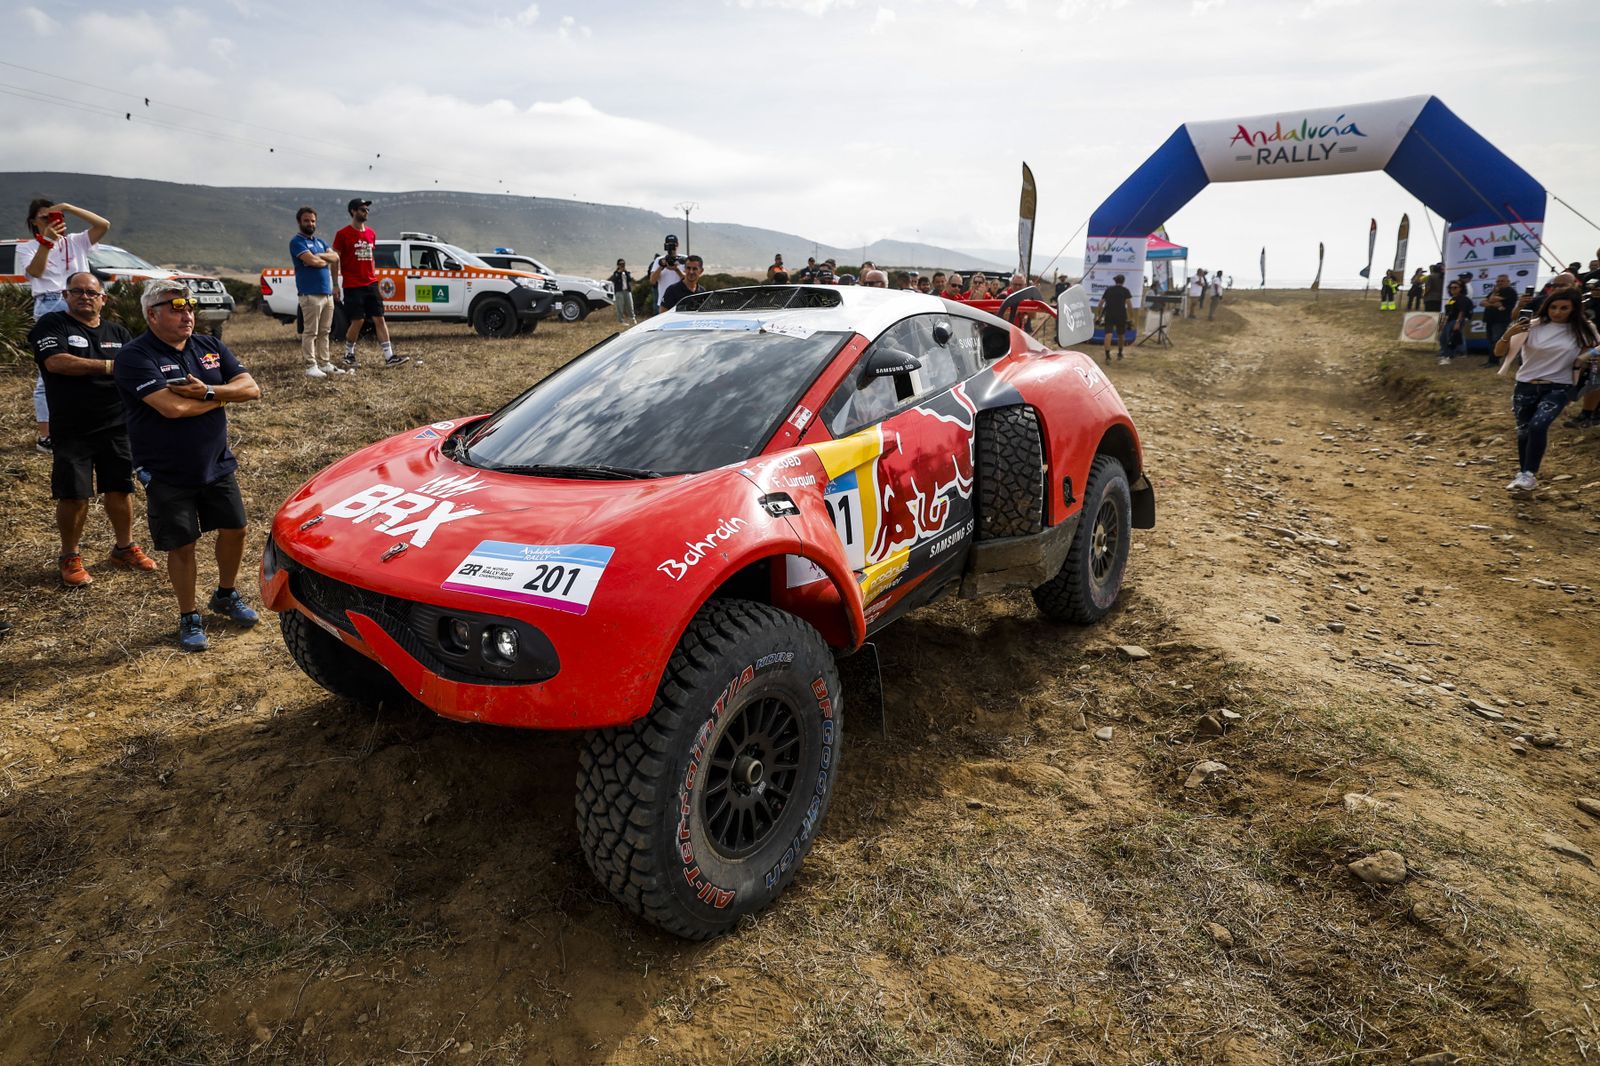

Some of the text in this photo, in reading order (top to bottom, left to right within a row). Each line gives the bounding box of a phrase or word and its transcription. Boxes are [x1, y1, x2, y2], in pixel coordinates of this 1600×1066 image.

[1230, 113, 1368, 148] Andalucía
[1256, 141, 1338, 166] RALLY
[271, 276, 283, 284] H1
[875, 366, 904, 374] SAMSUNG
[771, 476, 786, 488] F.
[783, 472, 817, 489] Lurquin
[322, 483, 486, 549] BRX
[656, 516, 749, 582] Bahrain
[929, 526, 966, 559] SAMSUNG
[522, 564, 581, 596] 201
